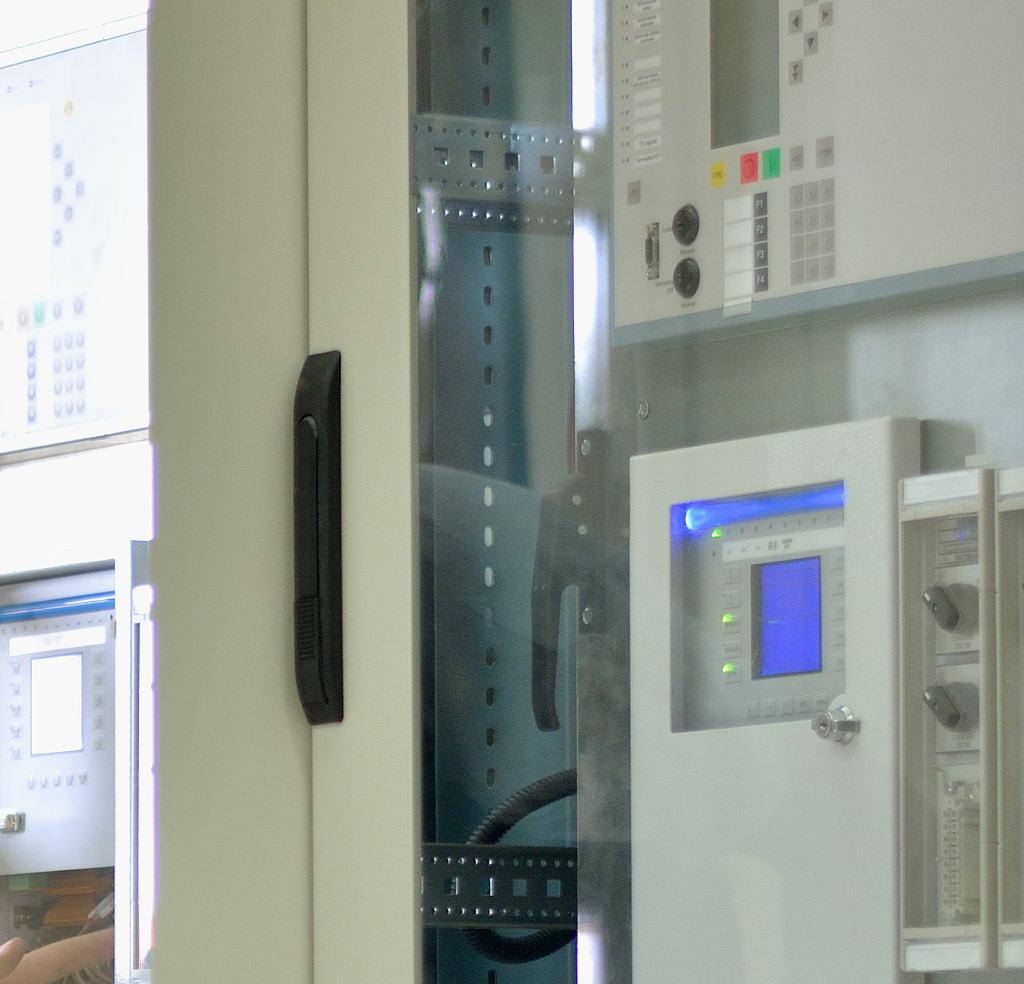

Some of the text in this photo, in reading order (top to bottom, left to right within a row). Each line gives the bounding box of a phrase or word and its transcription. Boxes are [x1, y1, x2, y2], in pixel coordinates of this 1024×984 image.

[756, 199, 764, 209] F1
[756, 225, 765, 234] F2
[756, 250, 765, 260] F3
[756, 275, 765, 284] F4
